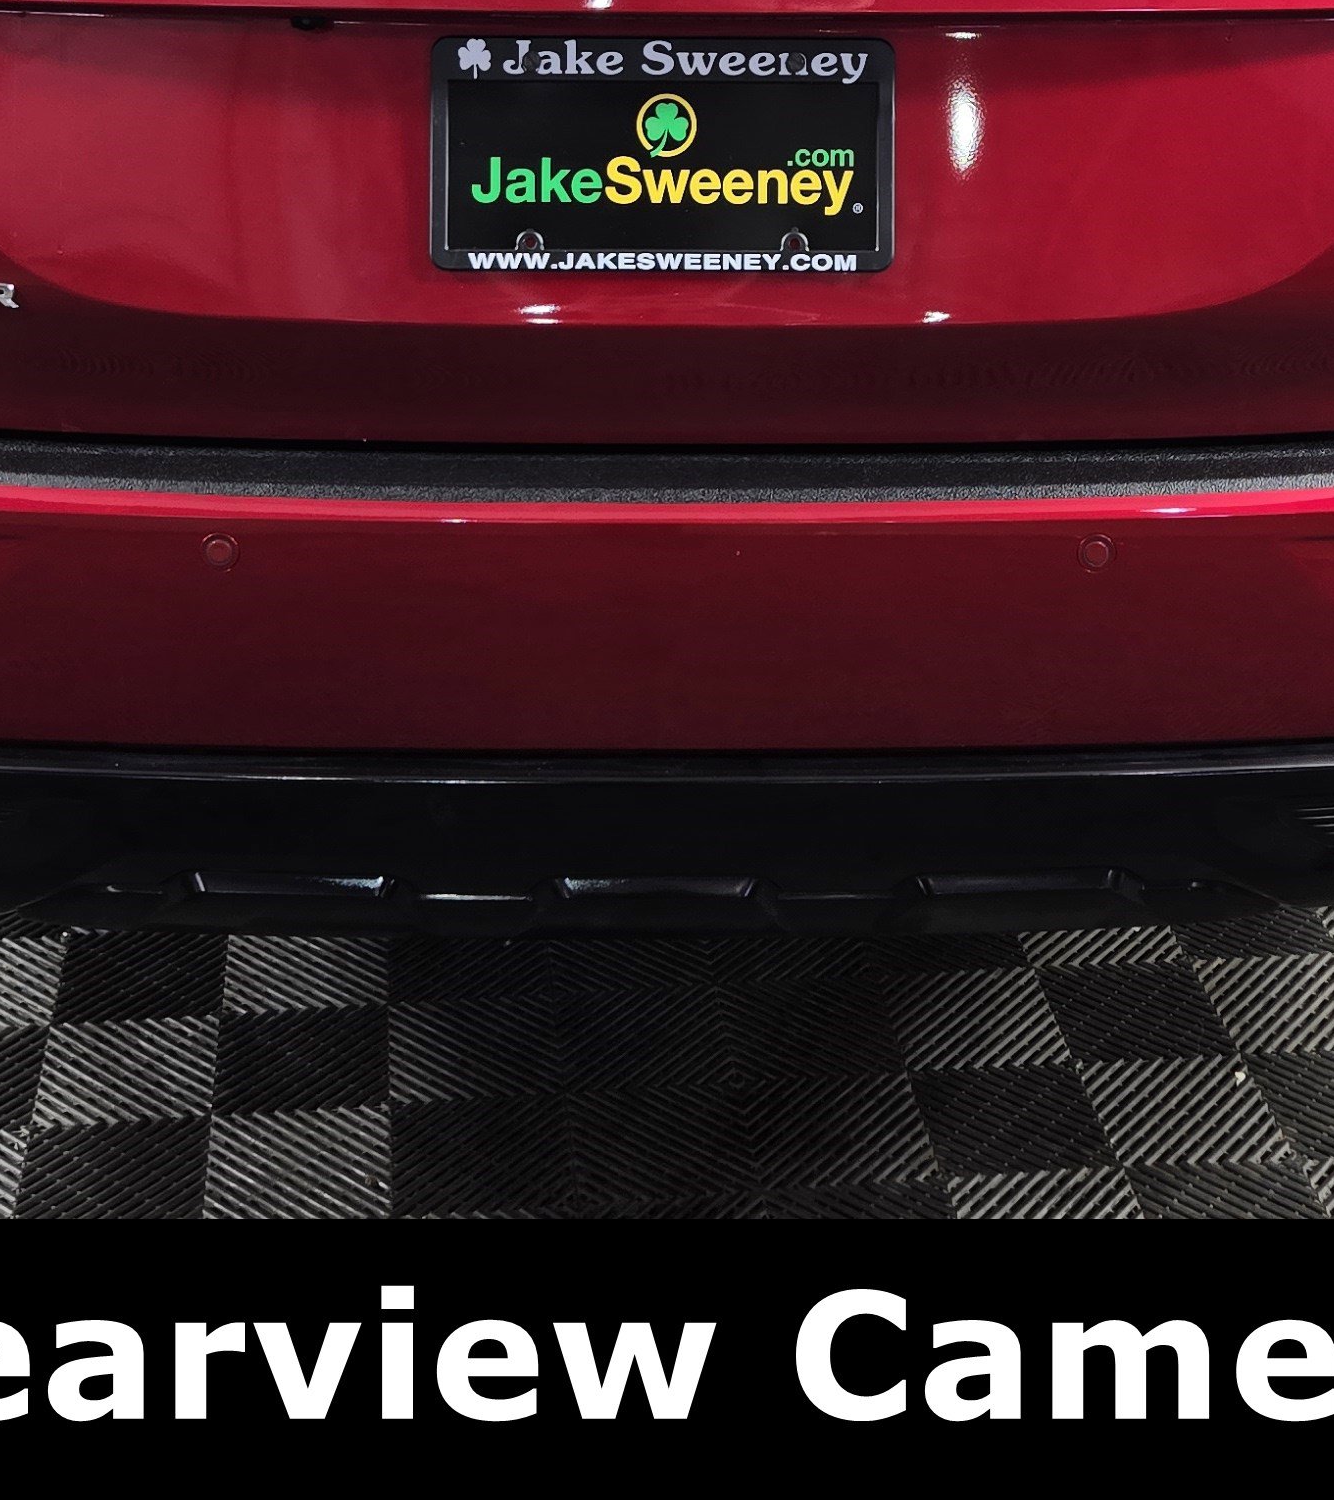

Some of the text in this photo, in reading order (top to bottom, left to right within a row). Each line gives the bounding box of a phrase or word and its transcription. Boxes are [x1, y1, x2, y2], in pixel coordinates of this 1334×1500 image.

[503, 39, 869, 84] Jake Sweeney
[467, 252, 857, 272] WWW.JAKESWEENEY.COM
